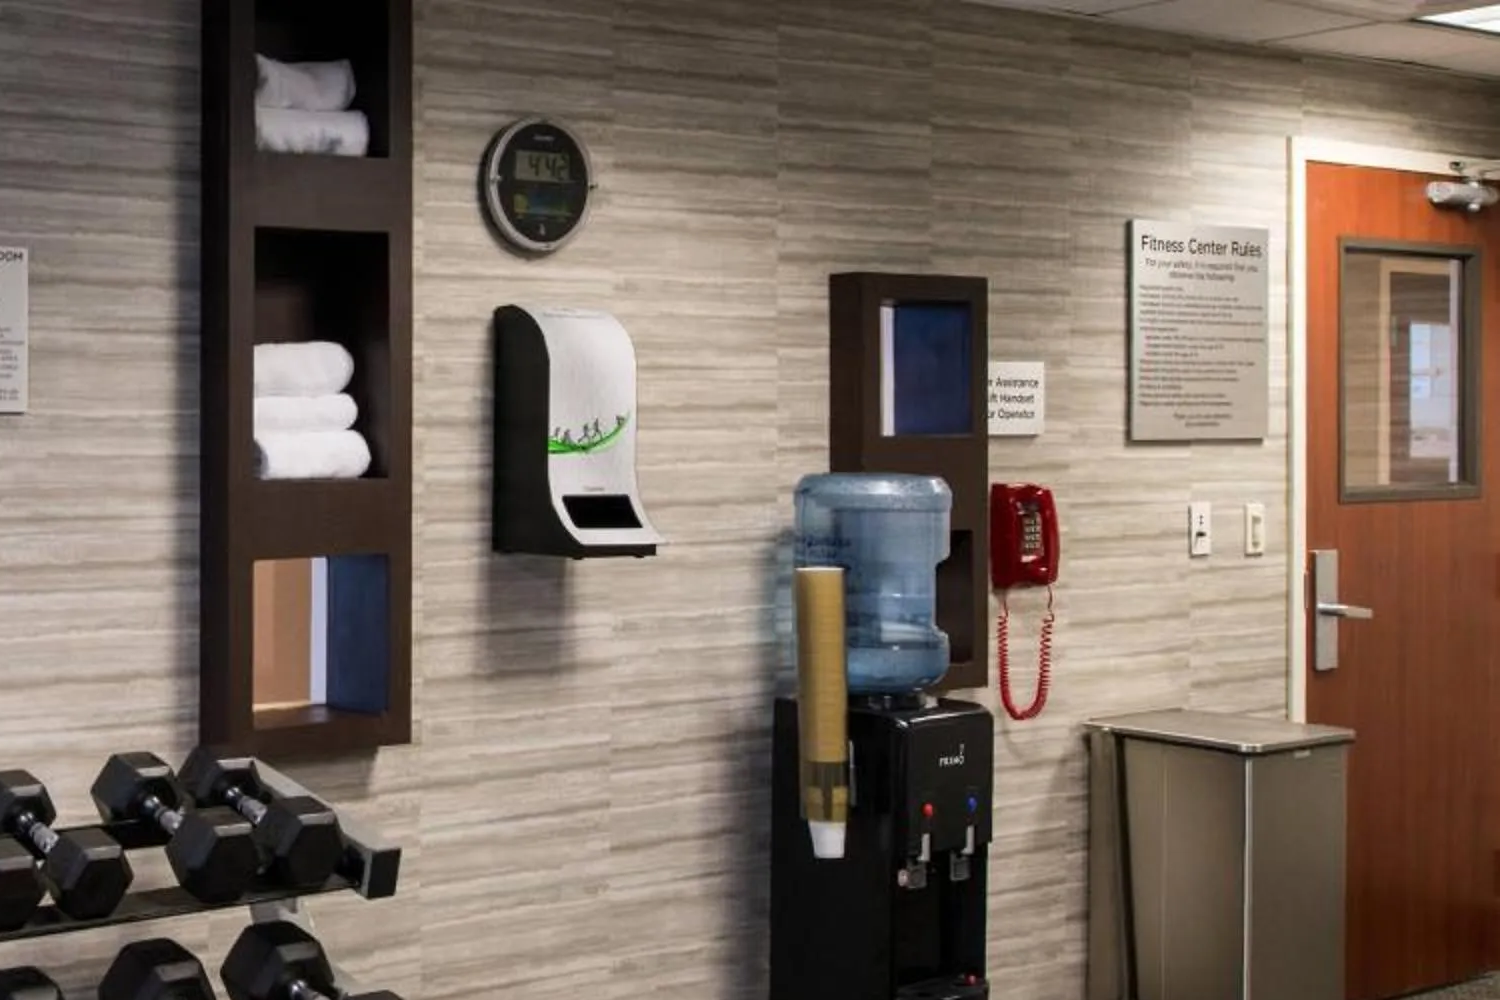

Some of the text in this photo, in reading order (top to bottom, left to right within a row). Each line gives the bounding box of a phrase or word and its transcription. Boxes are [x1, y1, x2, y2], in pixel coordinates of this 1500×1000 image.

[1141, 235, 1262, 259] Fitness Center Rules
[996, 376, 1039, 389] Assistance
